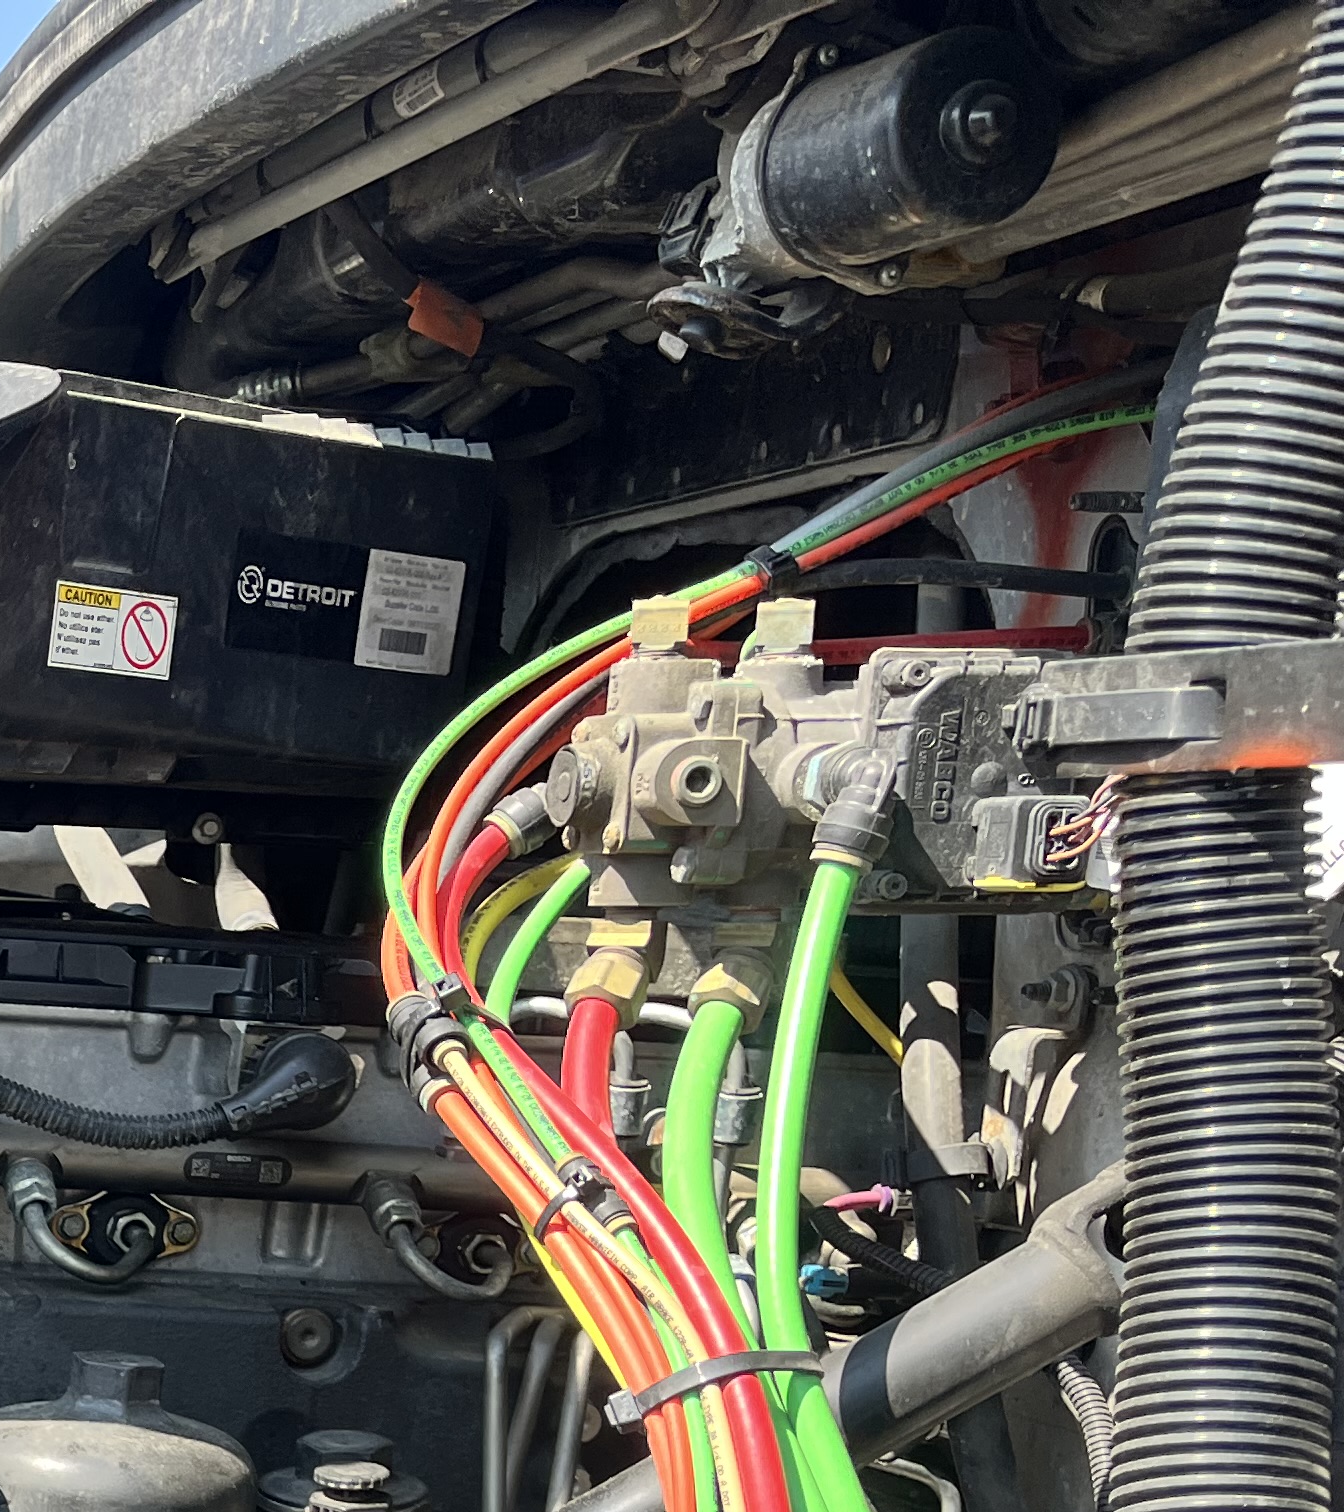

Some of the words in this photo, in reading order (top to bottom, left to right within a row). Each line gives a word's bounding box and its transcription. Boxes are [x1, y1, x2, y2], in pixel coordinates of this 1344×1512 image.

[65, 588, 112, 606] CAUTION
[266, 578, 354, 608] DETROIT
[59, 608, 68, 617] Do
[931, 709, 962, 822] WABCO
